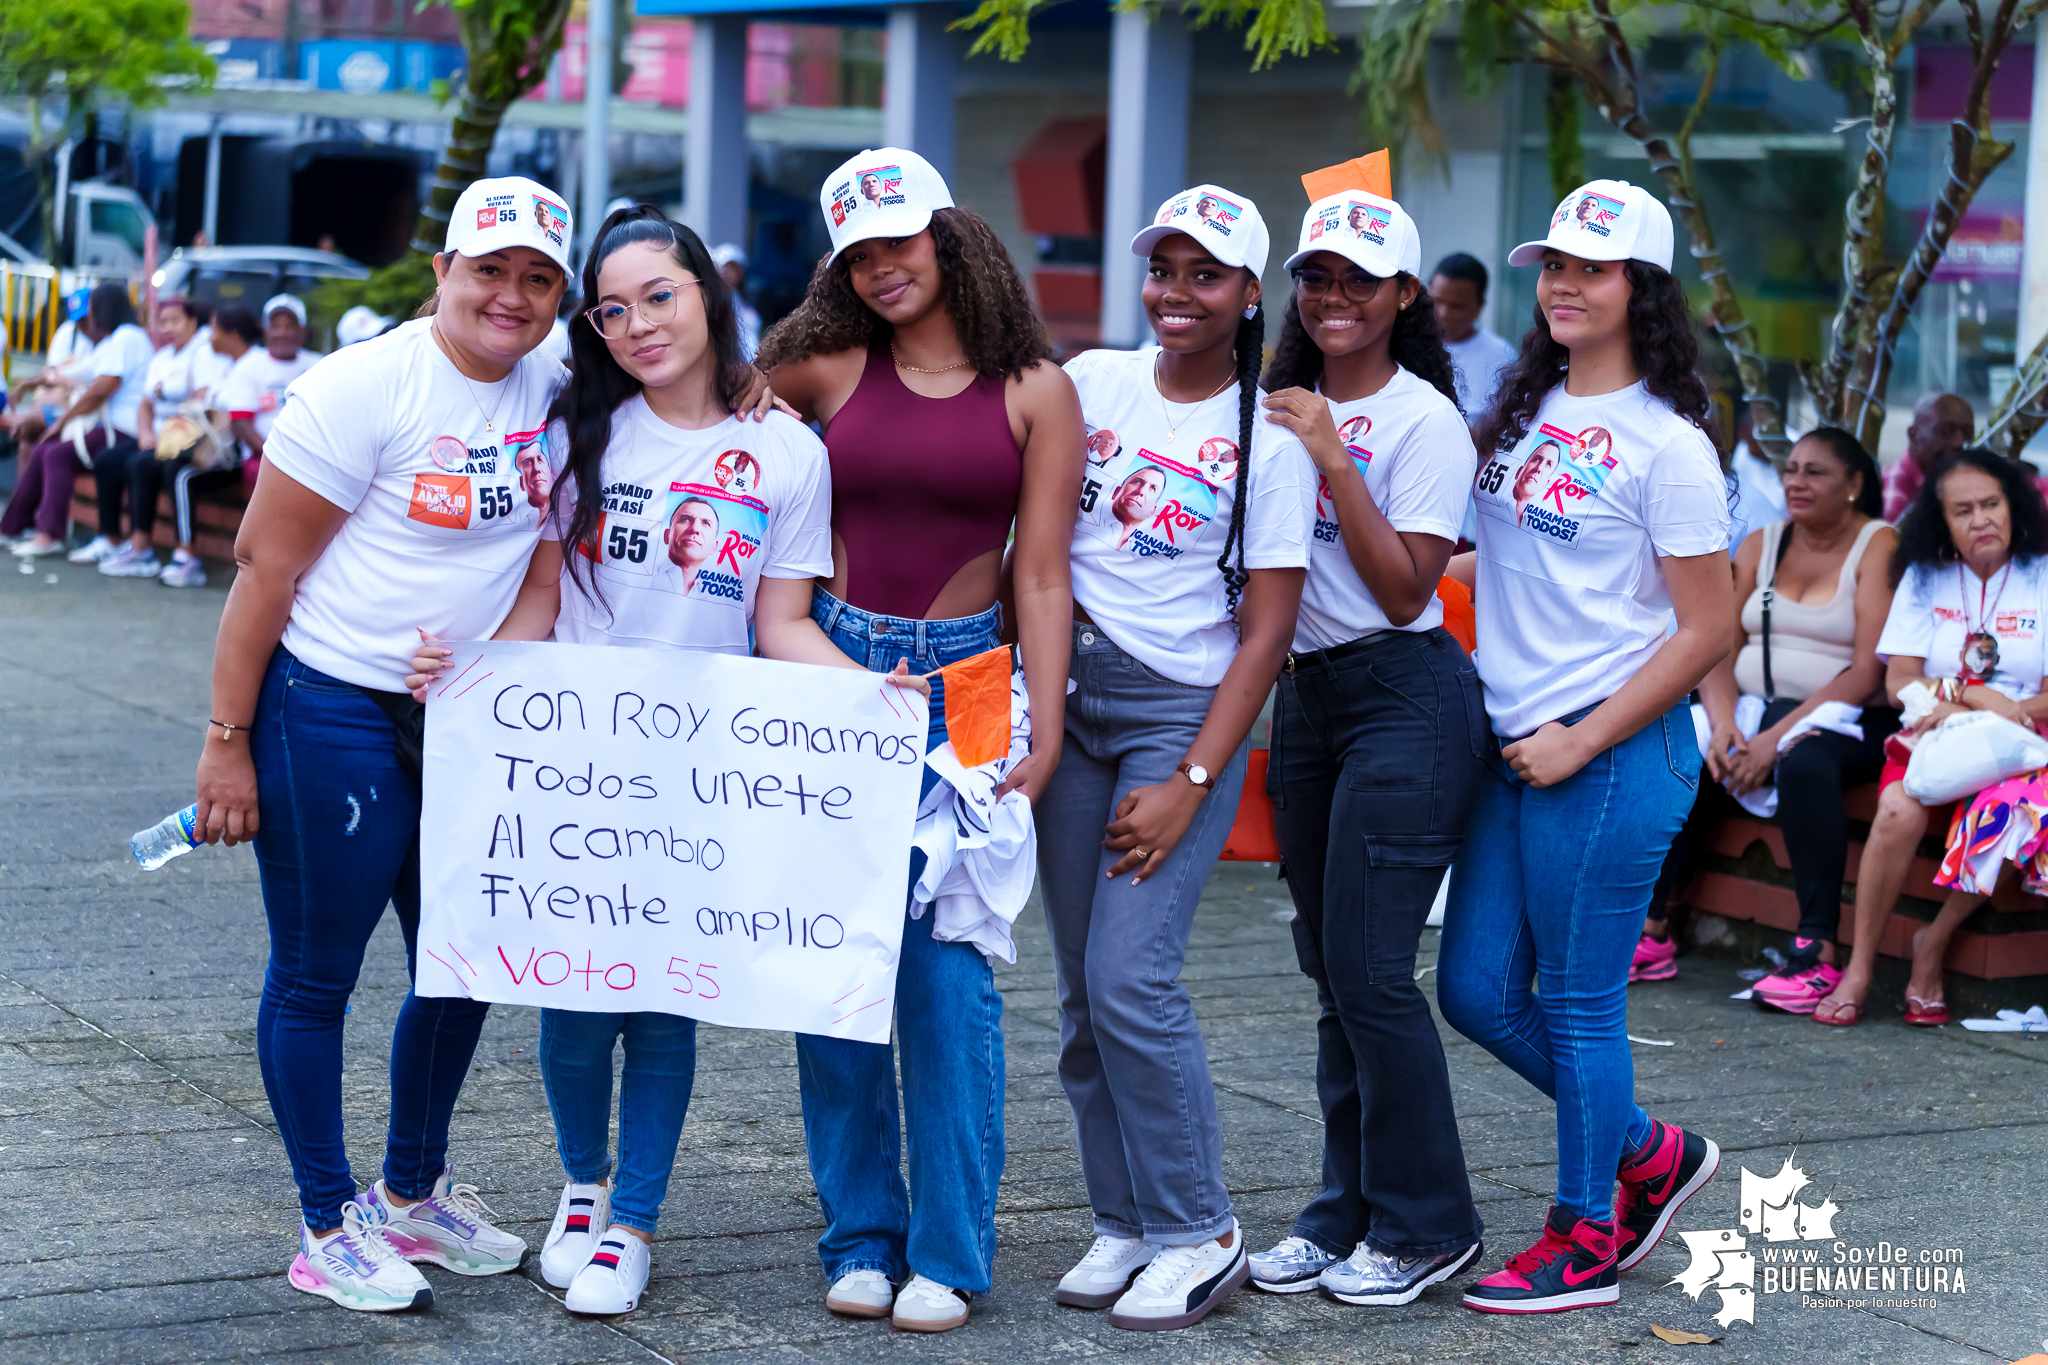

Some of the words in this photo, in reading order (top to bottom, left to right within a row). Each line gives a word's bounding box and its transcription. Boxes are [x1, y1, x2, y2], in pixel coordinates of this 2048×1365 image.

[844, 196, 857, 213] 55
[1173, 205, 1188, 218] 55
[499, 209, 517, 222] 55
[1216, 210, 1236, 226] ROY
[1595, 209, 1616, 226] ROY
[1325, 218, 1340, 231] 55
[1369, 218, 1387, 235] ROY
[469, 446, 498, 459] NADO
[1585, 452, 1595, 461] 55
[480, 459, 496, 474] ASÍ
[735, 478, 746, 488] 55
[1479, 461, 1509, 494] 55
[1573, 478, 1586, 487] SÓLO
[1586, 485, 1598, 494] CON
[421, 483, 448, 494] FRENTE
[1080, 476, 1102, 513] 5
[1542, 473, 1590, 516] ROY
[417, 490, 466, 508] AMPLIO
[479, 486, 513, 520] 55
[620, 500, 644, 515] ASÍ
[1152, 499, 1204, 545] ROY
[1183, 506, 1198, 516] SÓLO
[1198, 513, 1211, 522] CON
[1524, 503, 1579, 531] ¡GANAMOS
[1314, 528, 1338, 543] OS!
[1527, 515, 1577, 542] TODOS!
[608, 525, 649, 563] 55
[717, 530, 757, 578] ROY
[696, 569, 743, 589] ¡GANAM
[2020, 619, 2035, 629] 72
[495, 753, 658, 800] Todos
[668, 956, 720, 999] 55
